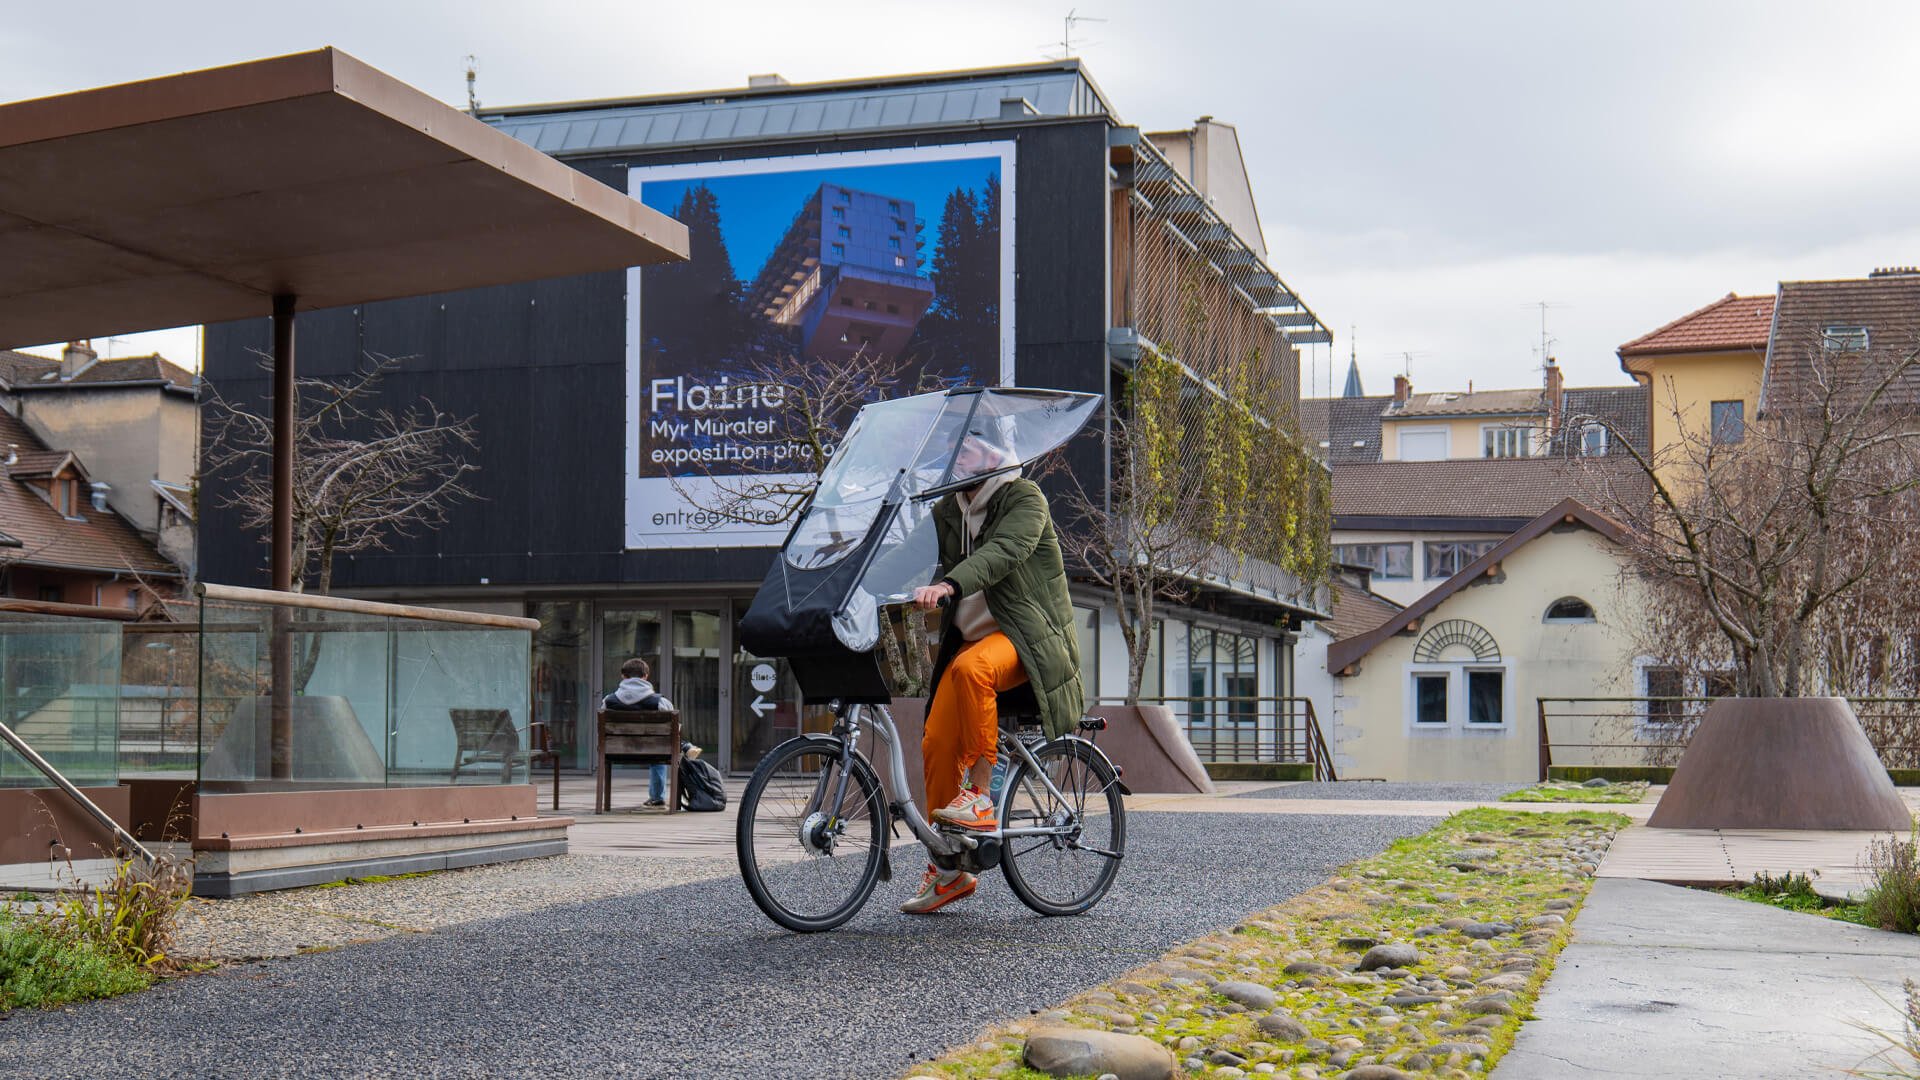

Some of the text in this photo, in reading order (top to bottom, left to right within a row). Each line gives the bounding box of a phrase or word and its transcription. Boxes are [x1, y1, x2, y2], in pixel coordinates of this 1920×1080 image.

[651, 376, 784, 412] Flaine
[651, 416, 776, 442] Myr Muratet
[651, 440, 835, 466] exposition phoo
